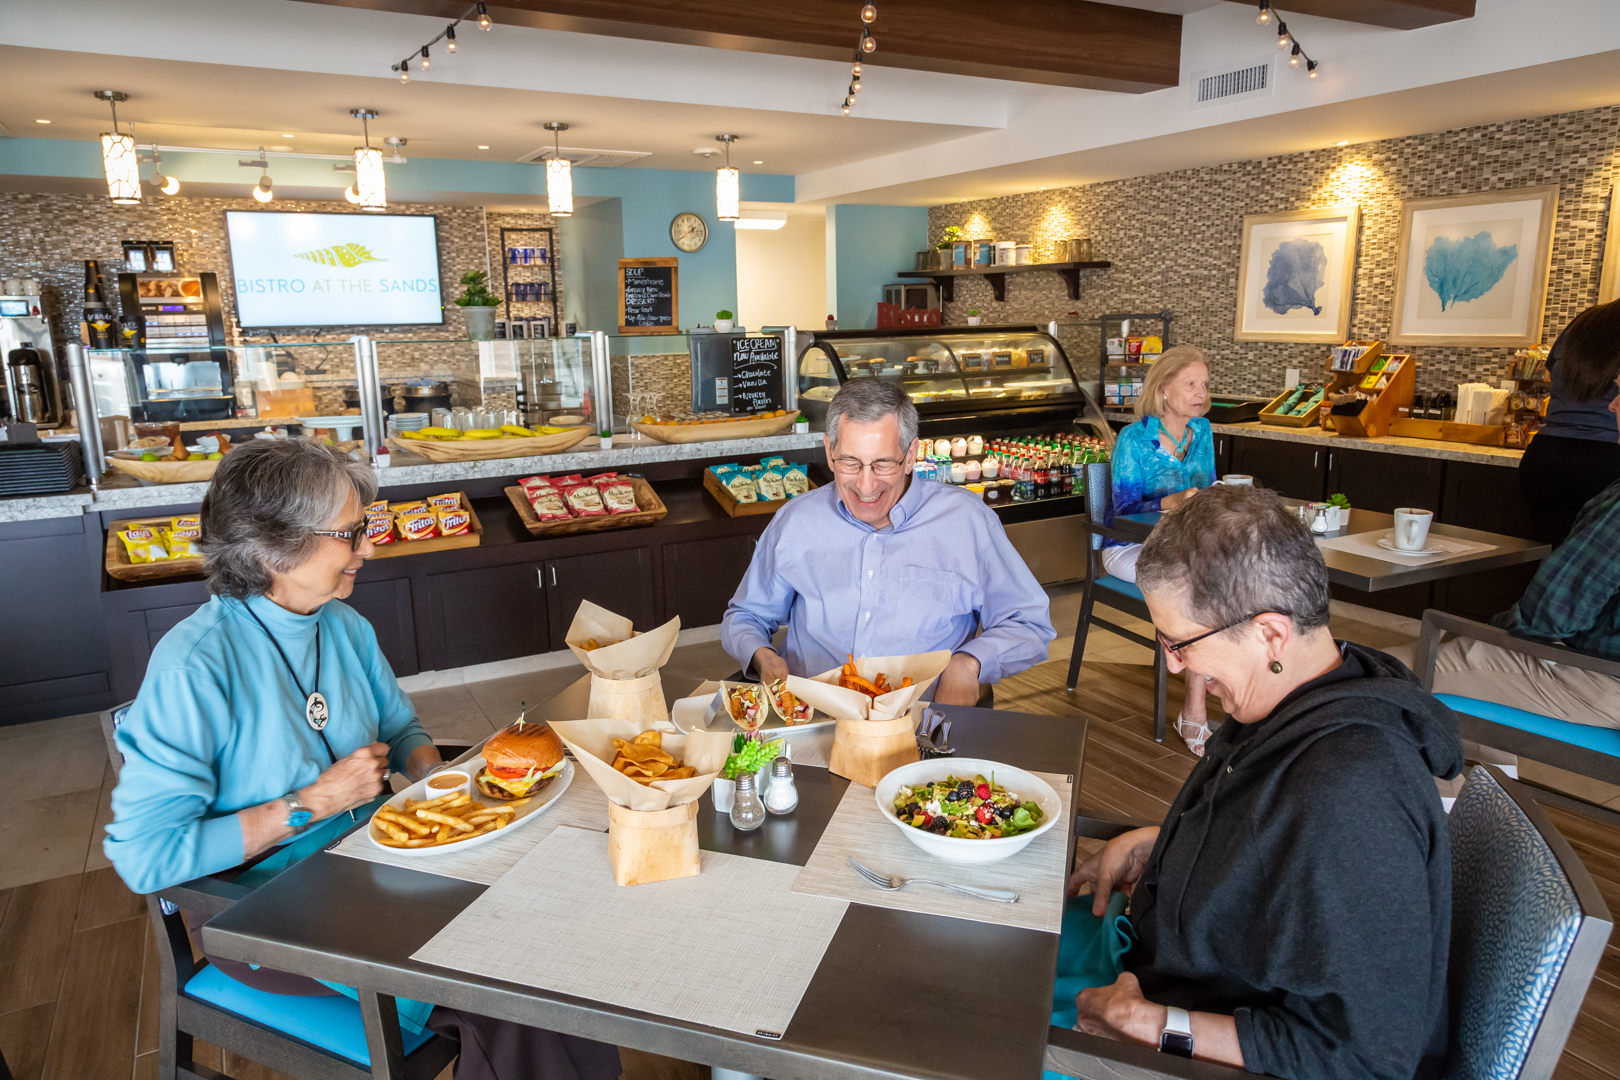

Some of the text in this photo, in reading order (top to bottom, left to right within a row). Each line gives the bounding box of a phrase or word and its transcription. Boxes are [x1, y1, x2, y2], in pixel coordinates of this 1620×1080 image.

[237, 278, 438, 294] BISTRO AT THE SANDS
[736, 338, 777, 351] ICE CREAM
[749, 351, 779, 365] Available
[741, 368, 772, 379] Chocolate
[742, 379, 768, 388] Vanilla
[406, 517, 434, 532] Fritos
[443, 515, 467, 530] Fritos
[366, 524, 389, 538] ritos
